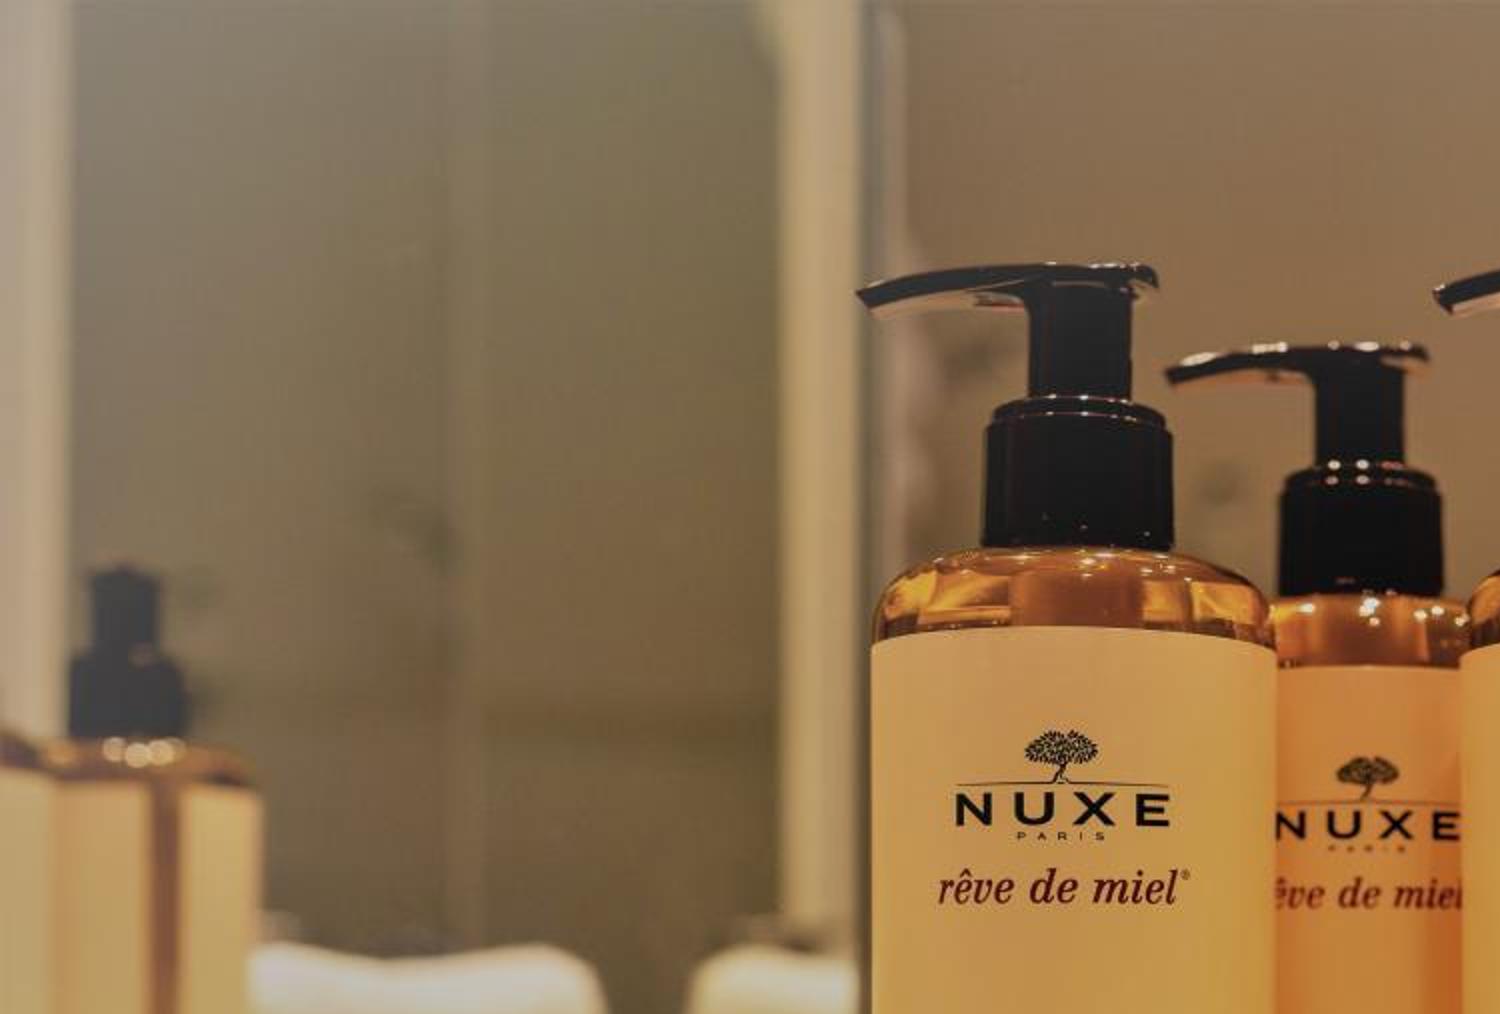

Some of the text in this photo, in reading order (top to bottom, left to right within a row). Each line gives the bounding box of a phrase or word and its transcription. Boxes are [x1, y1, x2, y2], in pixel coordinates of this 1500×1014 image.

[955, 791, 1171, 828] NUXE
[1274, 809, 1462, 843] NUXE
[1015, 831, 1105, 842] PARIS
[938, 867, 1015, 906] rêve
[1029, 867, 1079, 905] de
[1274, 875, 1326, 911] êve
[1337, 875, 1383, 909] de
